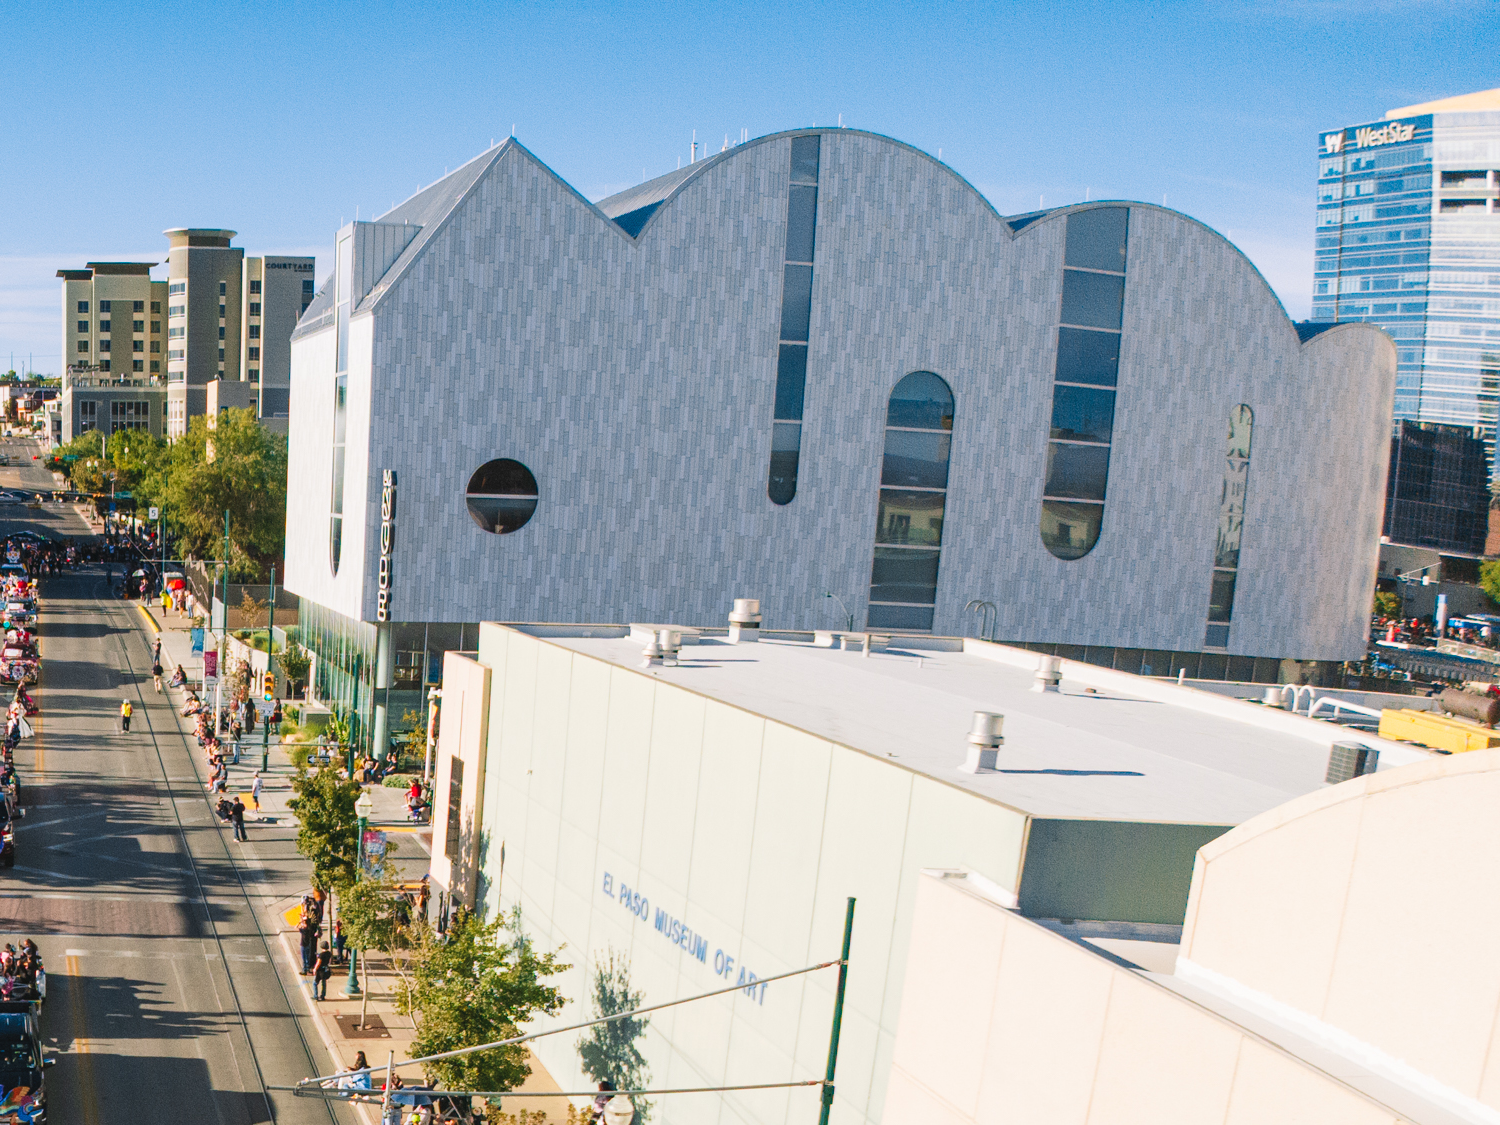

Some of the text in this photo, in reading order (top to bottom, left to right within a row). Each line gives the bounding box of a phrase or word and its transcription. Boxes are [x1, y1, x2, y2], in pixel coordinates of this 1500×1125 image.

[1356, 121, 1415, 148] WestStar
[265, 262, 313, 270] COURTYARD
[602, 871, 768, 1006] EL PASO MUSEUM OF ART
